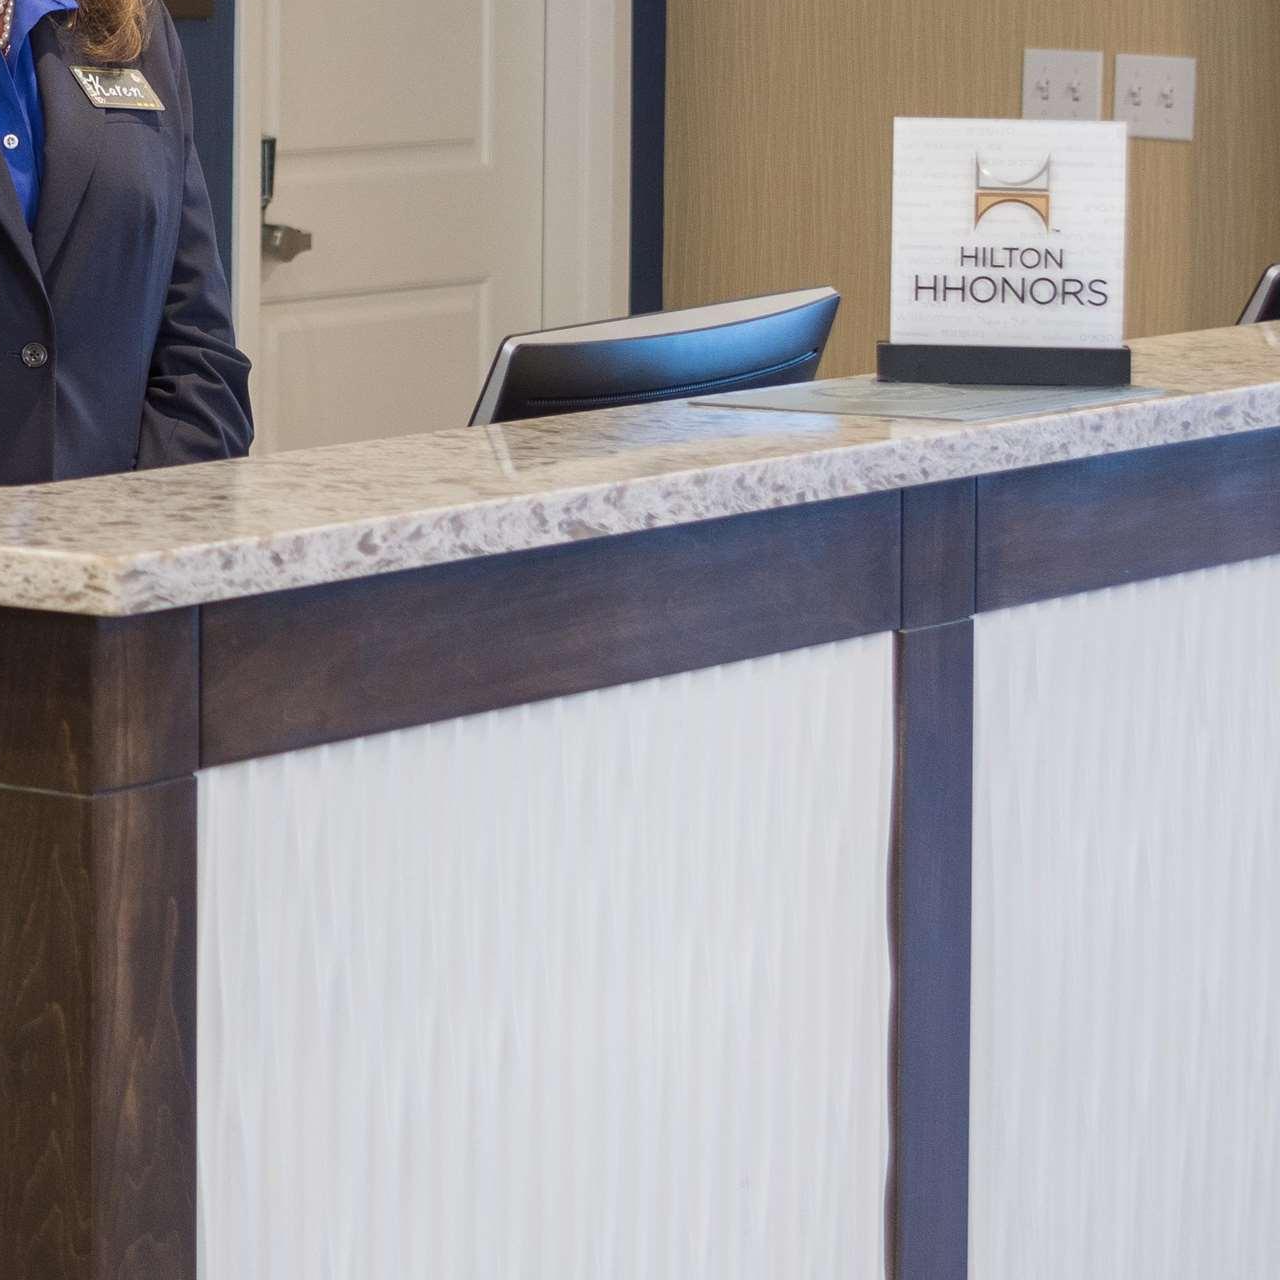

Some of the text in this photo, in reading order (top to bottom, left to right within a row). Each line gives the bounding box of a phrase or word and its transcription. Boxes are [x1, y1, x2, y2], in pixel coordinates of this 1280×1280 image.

[87, 73, 144, 98] Karen
[959, 246, 1064, 270] HILTON
[913, 274, 1109, 307] HHONORS
